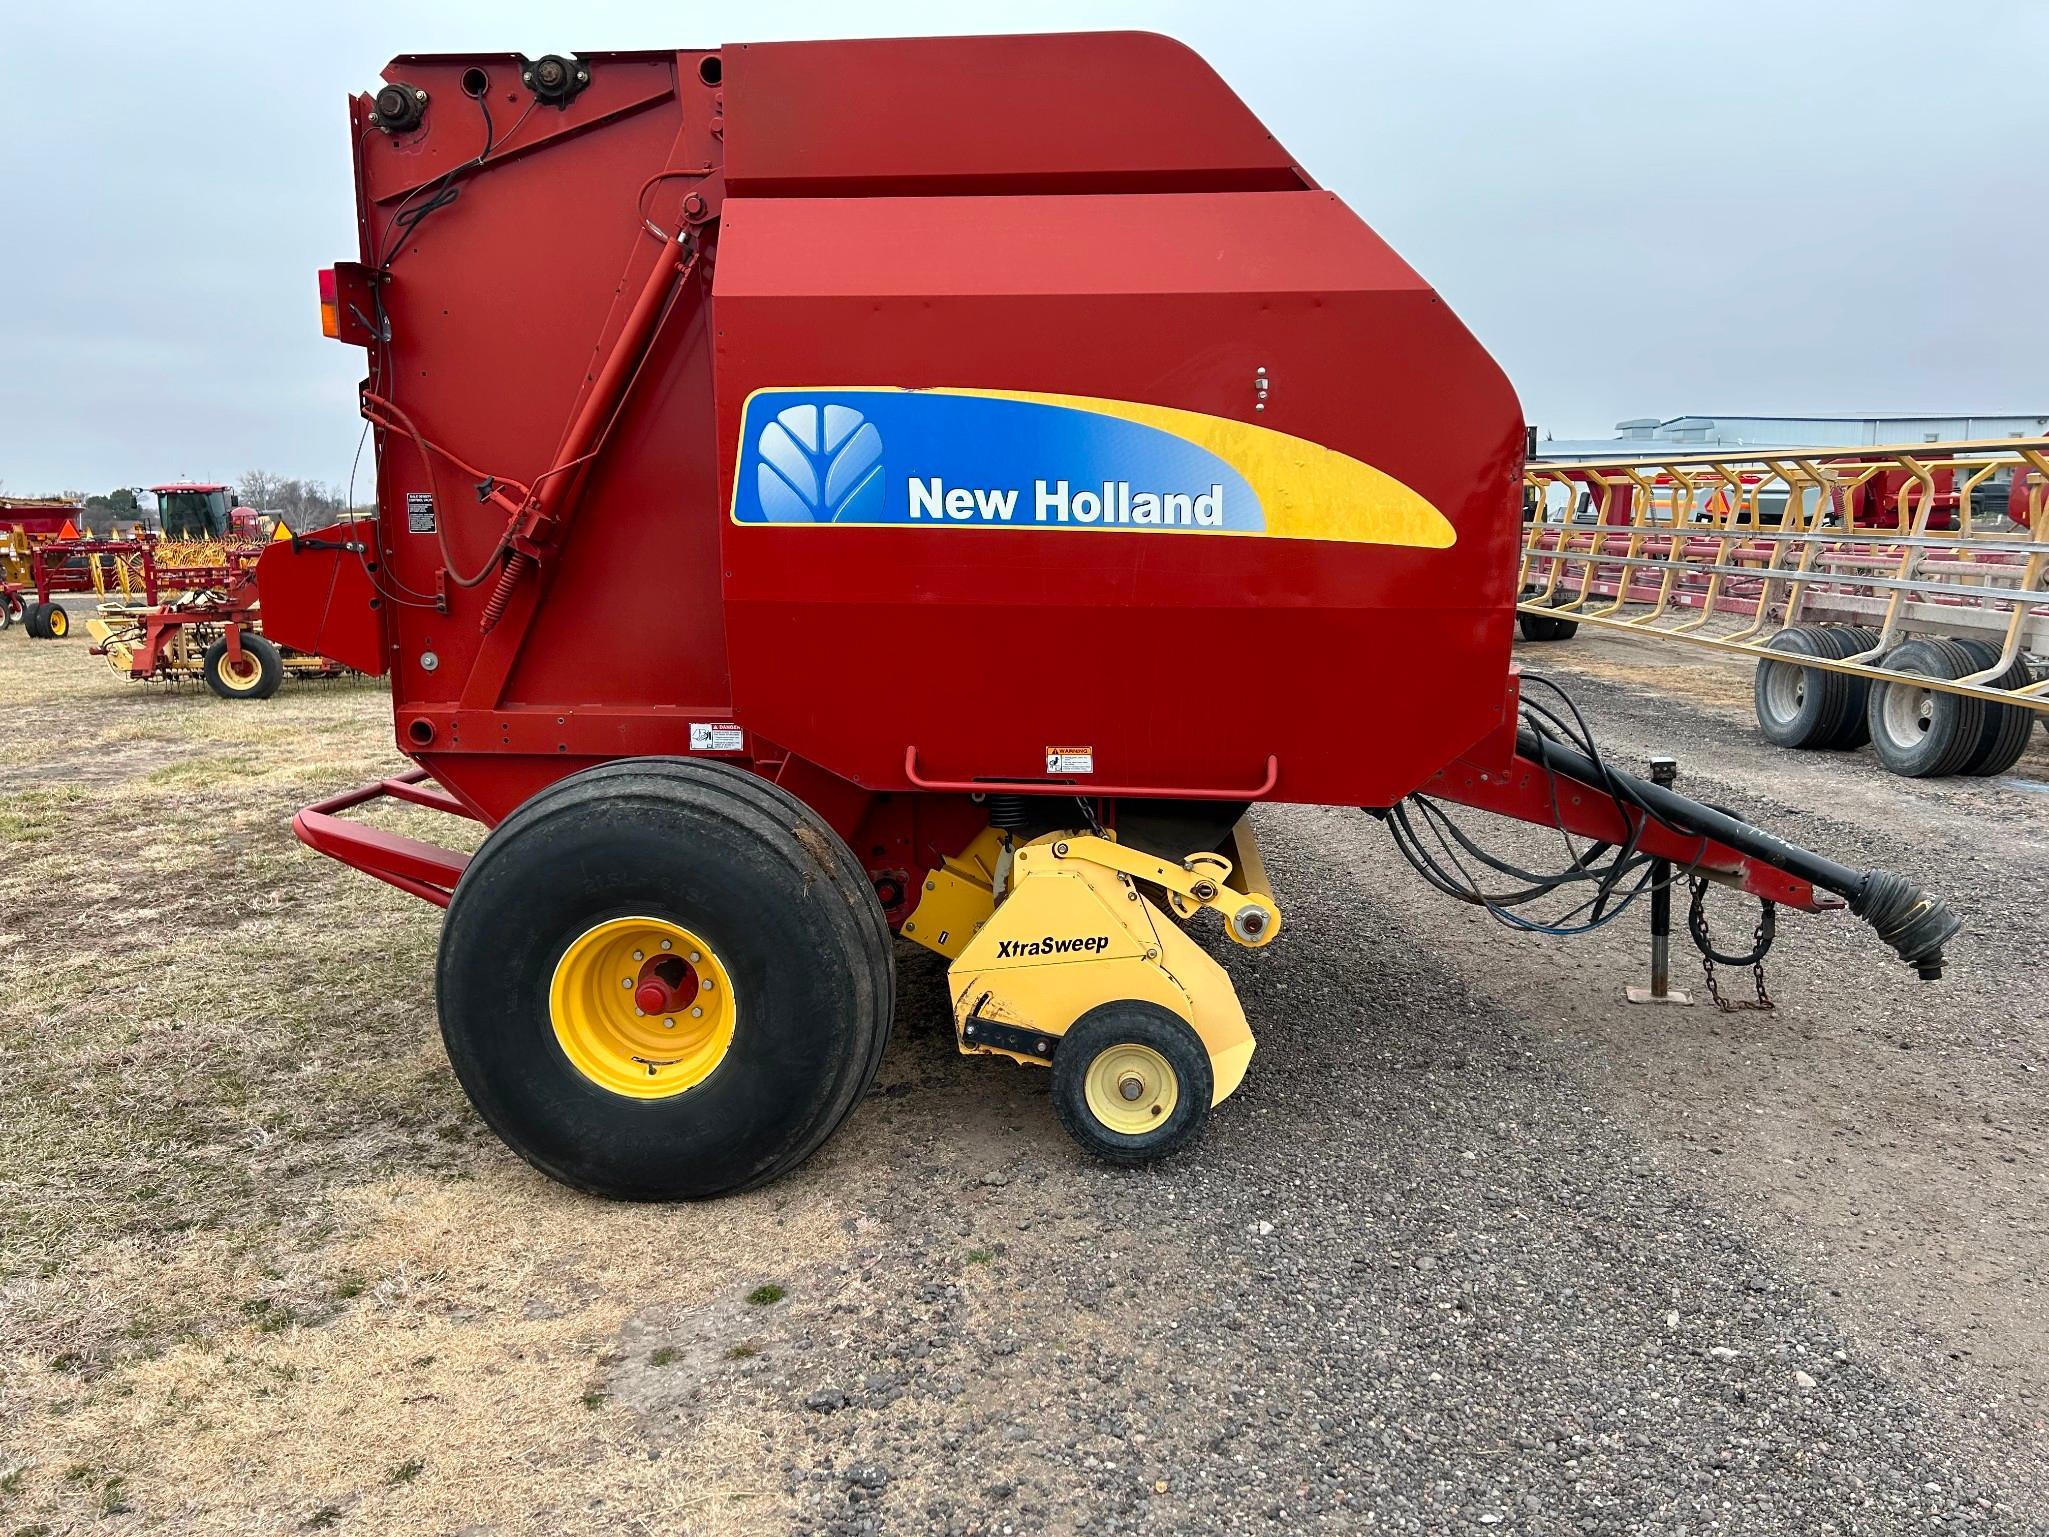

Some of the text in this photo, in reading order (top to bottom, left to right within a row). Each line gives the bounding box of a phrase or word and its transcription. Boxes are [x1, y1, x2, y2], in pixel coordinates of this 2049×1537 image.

[907, 479, 1224, 526] New Holland
[996, 936, 1109, 958] XtraSweep
